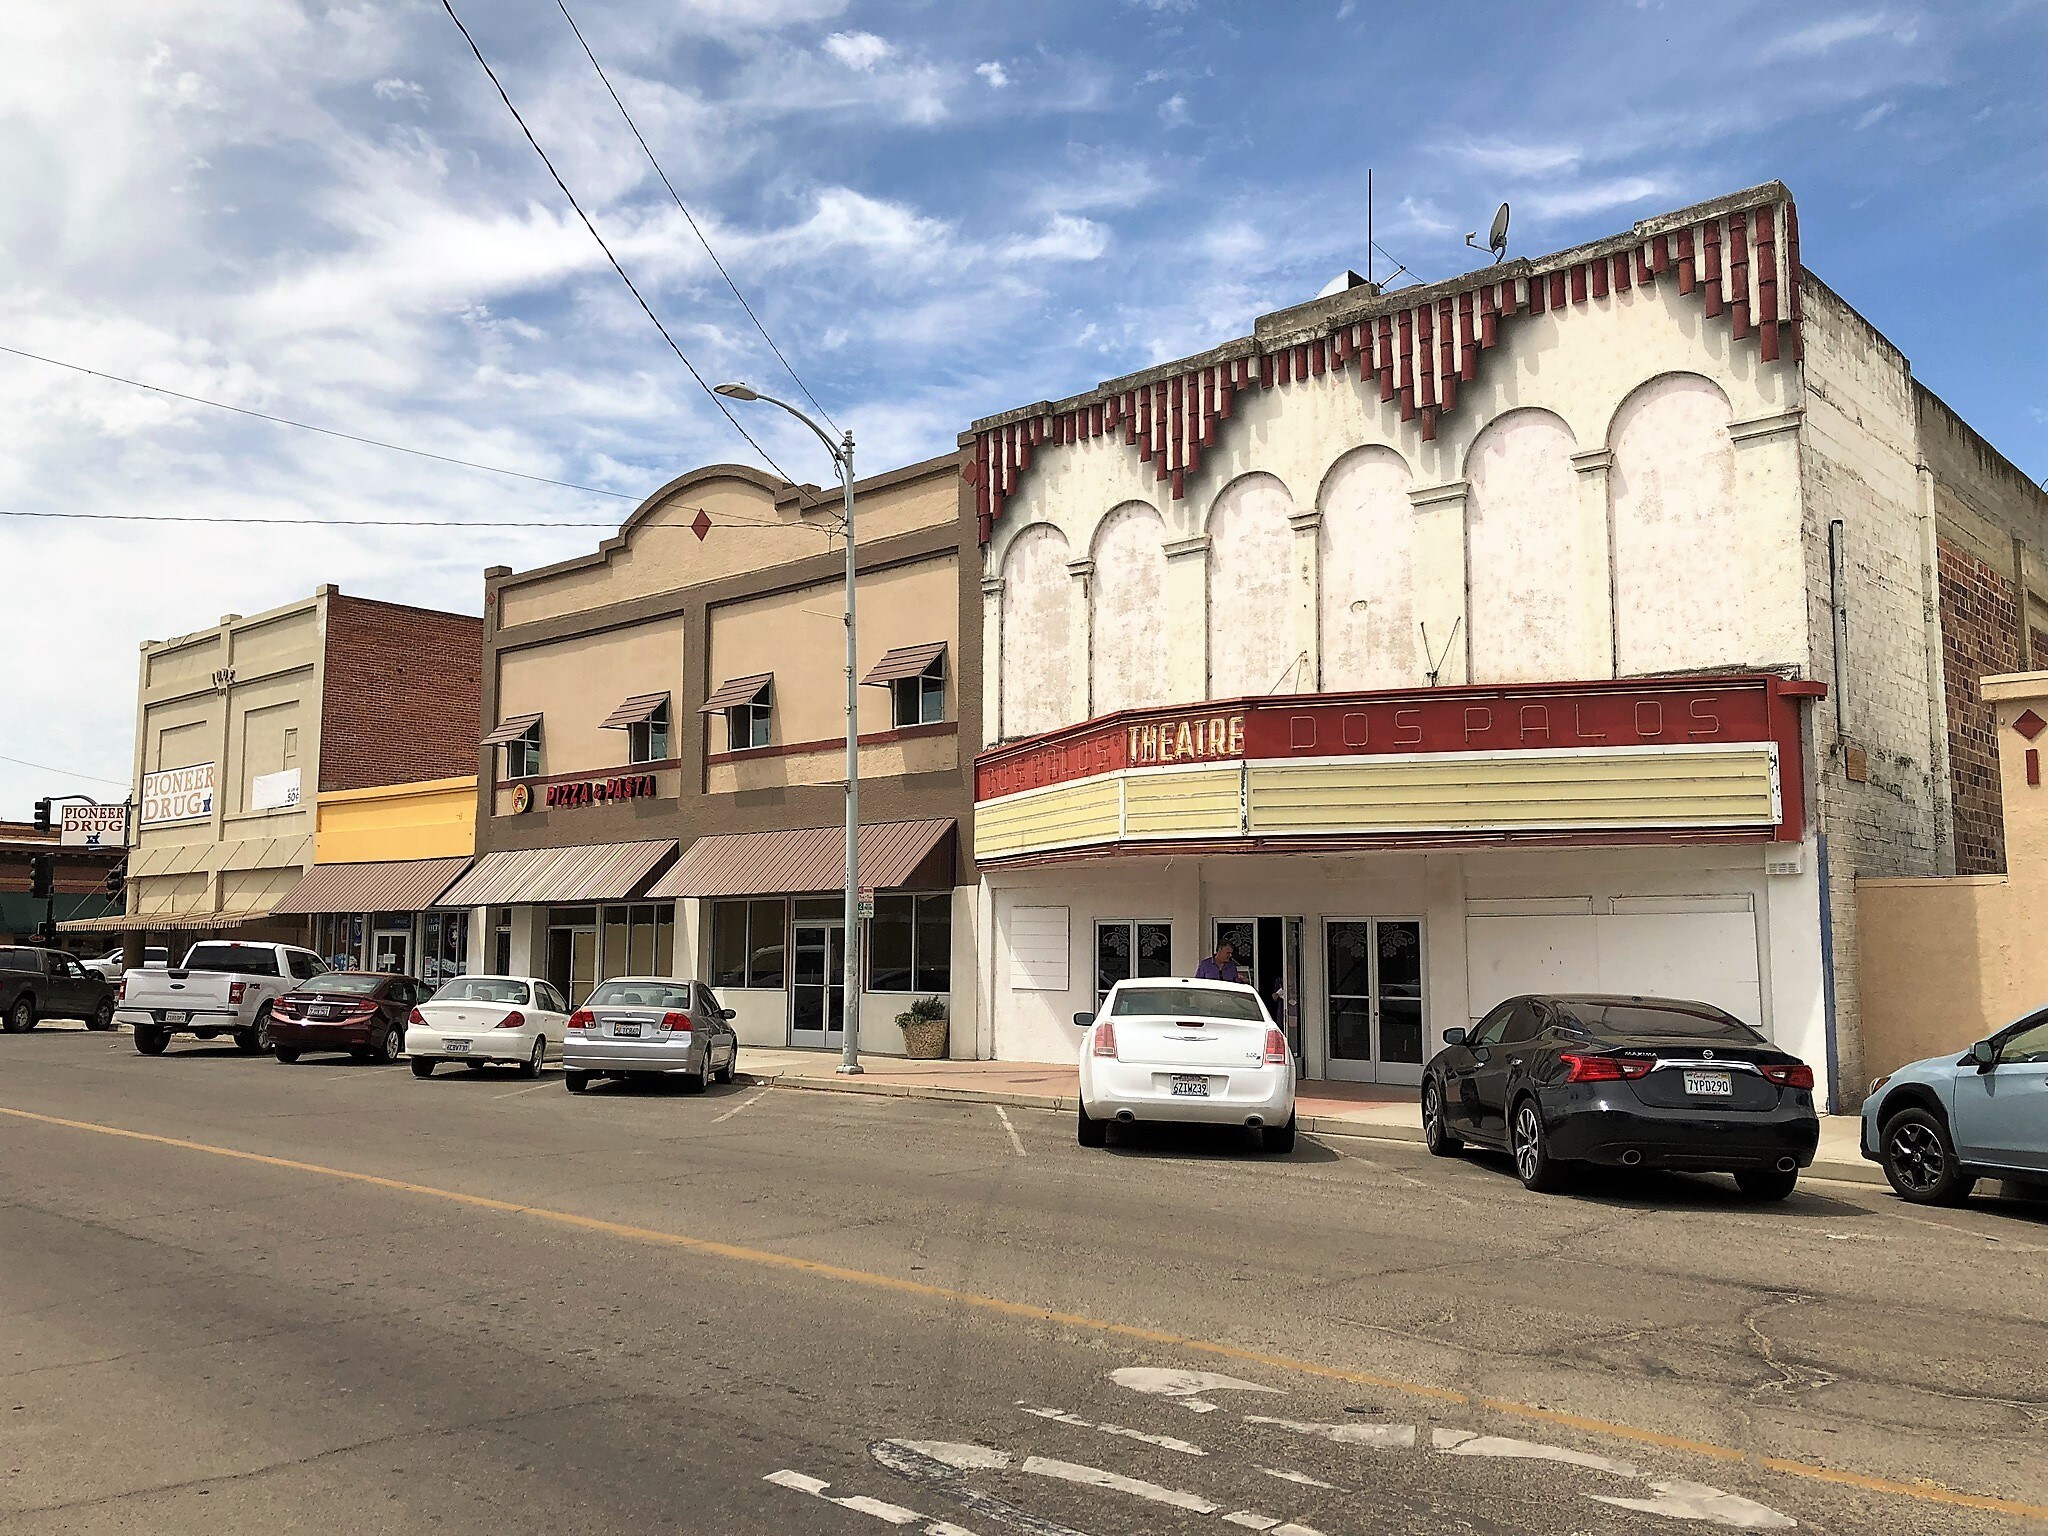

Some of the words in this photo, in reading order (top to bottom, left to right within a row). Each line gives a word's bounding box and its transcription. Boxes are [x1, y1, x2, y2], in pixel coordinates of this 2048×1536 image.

[1290, 709, 1422, 749] DOS
[1463, 698, 1719, 743] PALOS
[1127, 716, 1244, 765] THEATRE
[144, 766, 215, 798] PIONEER
[546, 782, 593, 806] PIZZA
[593, 783, 606, 801] &
[606, 775, 656, 800] PASTA
[64, 807, 124, 819] PIONEER
[144, 792, 202, 821] DRUG
[64, 820, 123, 832] DRUG
[1687, 1079, 1729, 1093] 7YPD290
